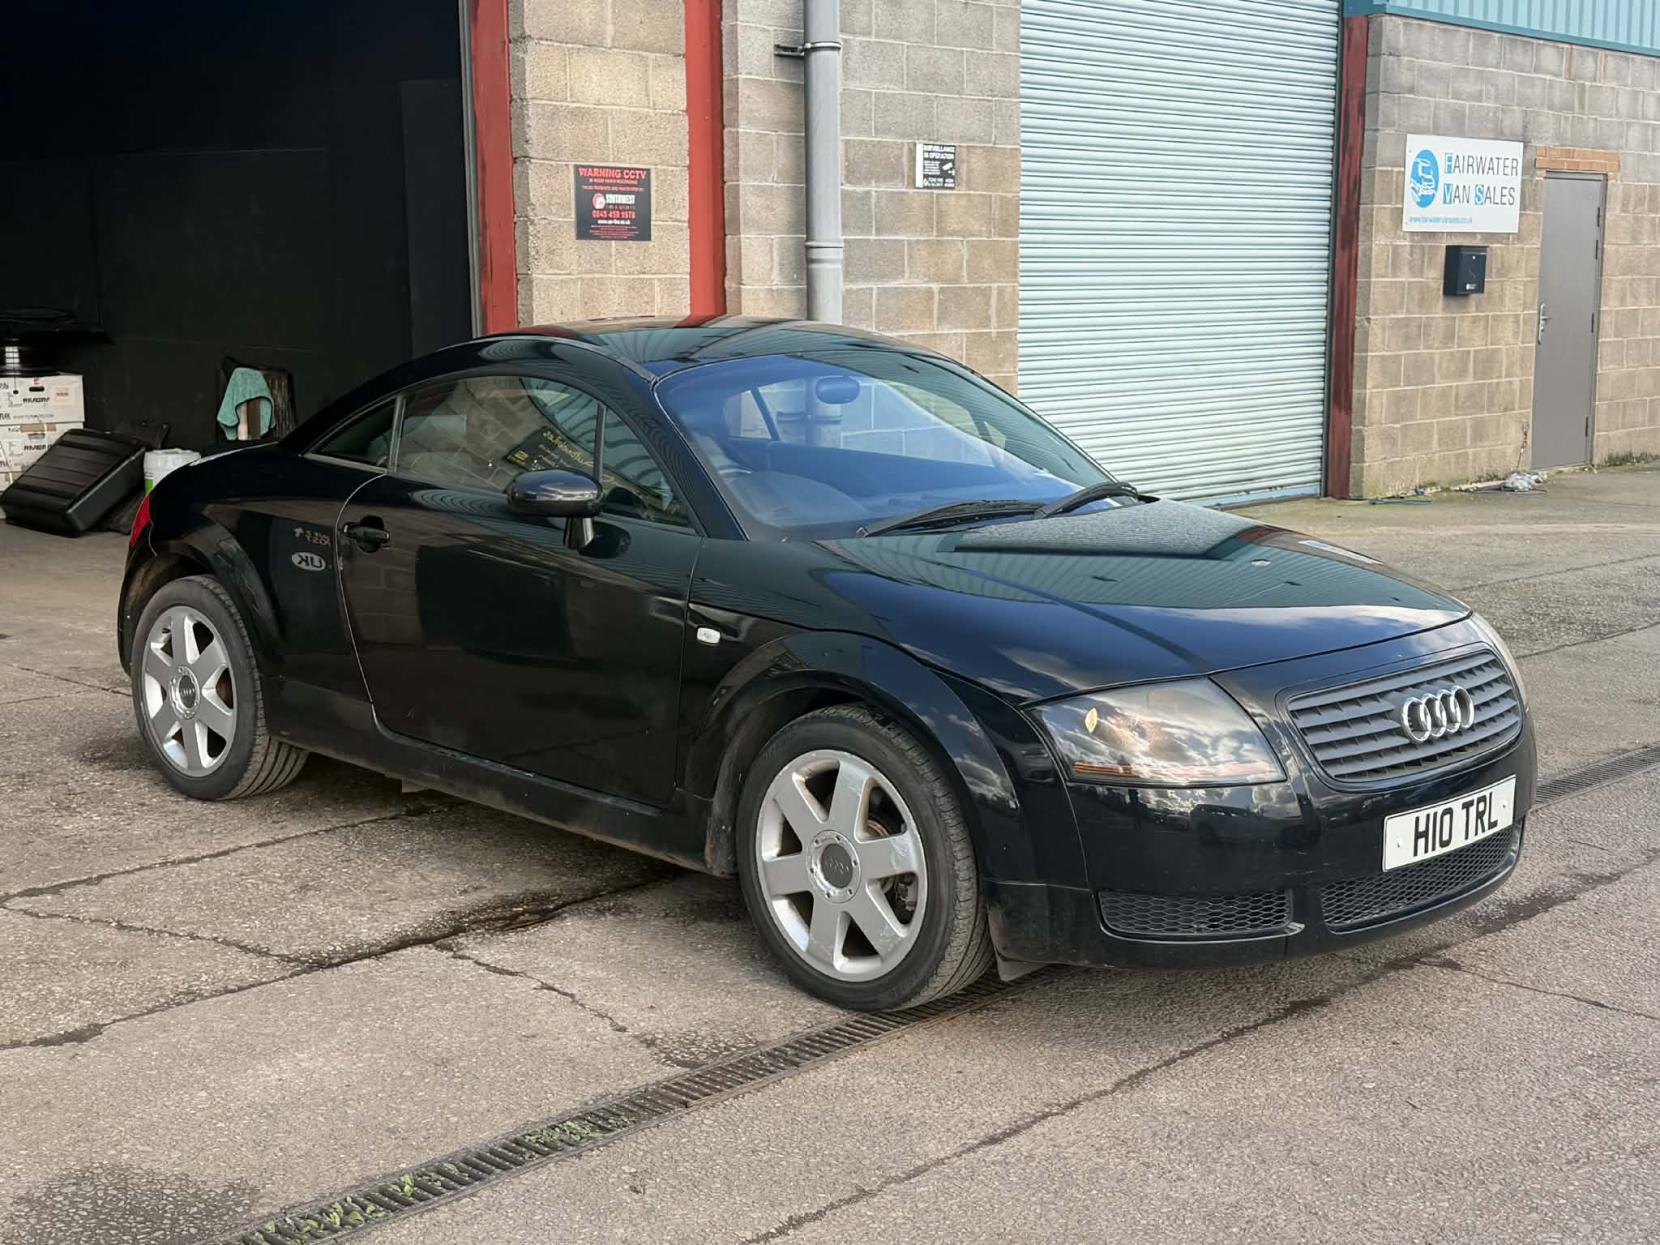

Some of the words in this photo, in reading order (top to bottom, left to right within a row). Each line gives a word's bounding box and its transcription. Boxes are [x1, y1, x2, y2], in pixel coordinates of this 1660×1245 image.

[578, 167, 622, 178] WARNING
[623, 170, 646, 178] CCTV
[1445, 152, 1519, 177] FAIRWATER
[1443, 183, 1471, 205] VAN
[1475, 184, 1516, 206] SALES
[1413, 807, 1454, 857] H10
[1462, 792, 1499, 840] TRL
